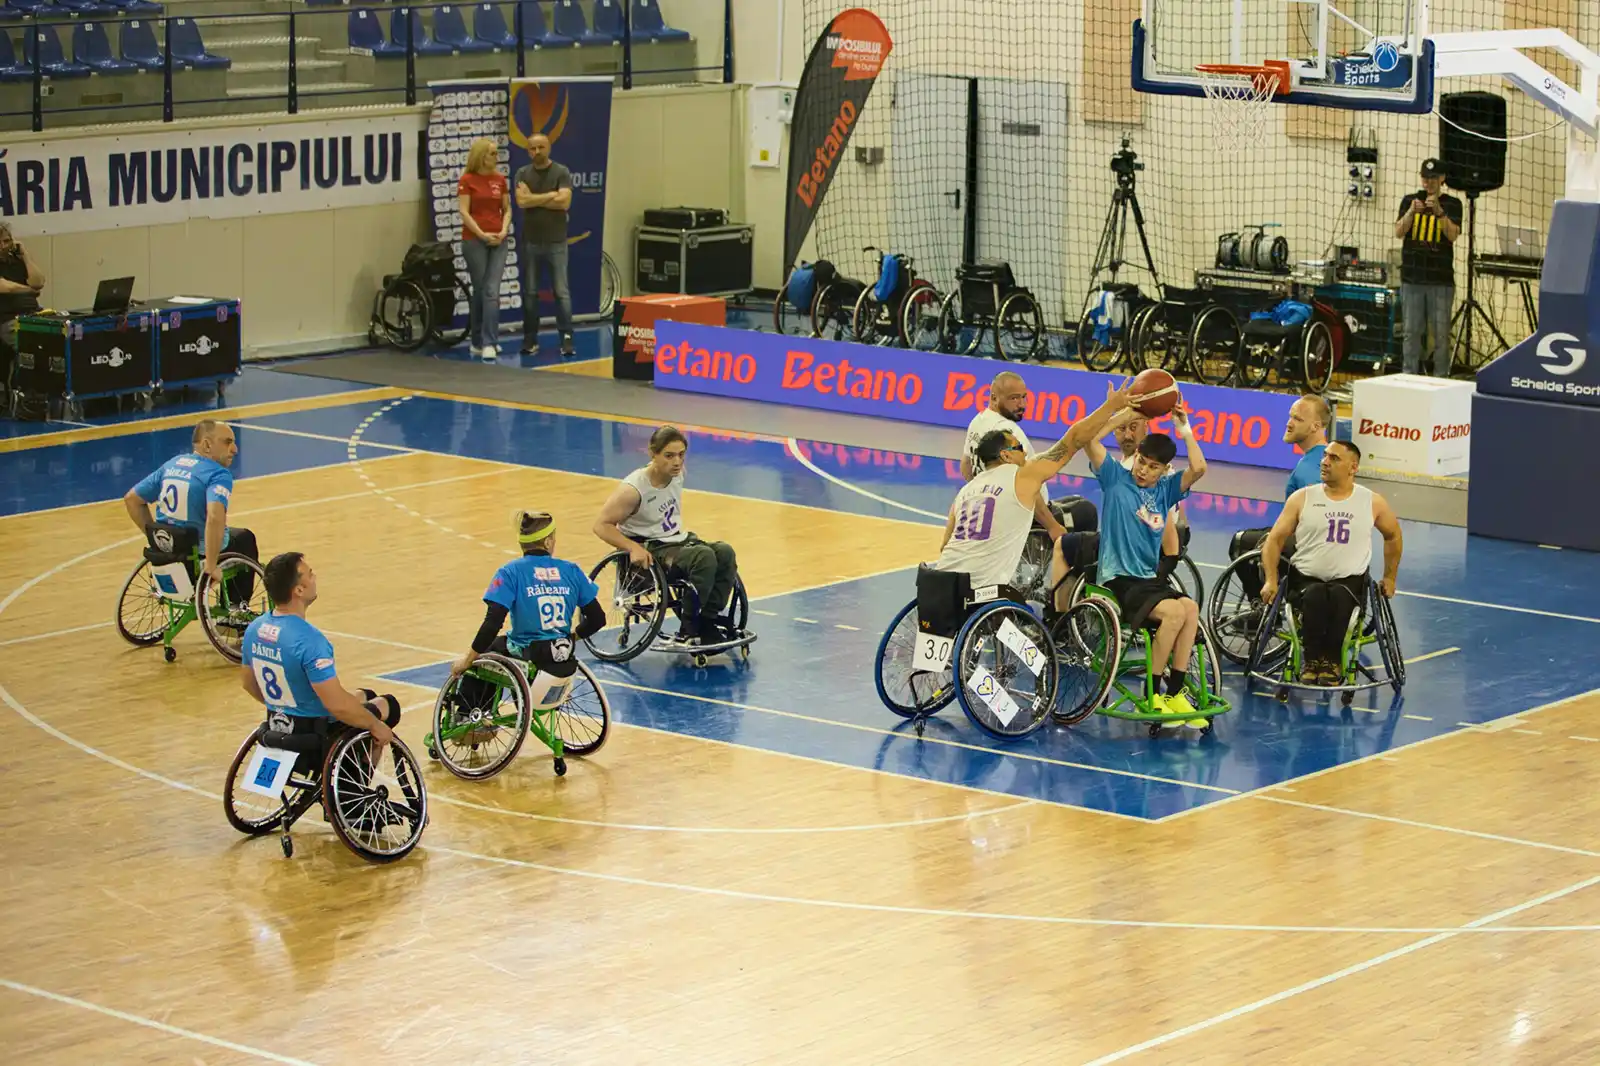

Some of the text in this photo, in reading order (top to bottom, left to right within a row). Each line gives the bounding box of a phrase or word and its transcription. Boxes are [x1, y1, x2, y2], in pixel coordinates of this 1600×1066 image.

[1344, 73, 1380, 86] Sports
[797, 100, 856, 208] Betano
[109, 132, 402, 207] MUNICIPIULUI
[179, 343, 196, 353] LED
[90, 355, 109, 365] LED
[781, 350, 923, 405] Betano
[1511, 376, 1563, 393] Schelde
[943, 371, 1086, 426] Beano
[1358, 418, 1421, 441] Betano
[1432, 422, 1470, 442] Betano
[955, 496, 996, 540] 10
[1326, 519, 1350, 544] 16
[924, 639, 949, 662] 3.0
[262, 666, 283, 700] 8
[257, 764, 277, 783] 2.0
